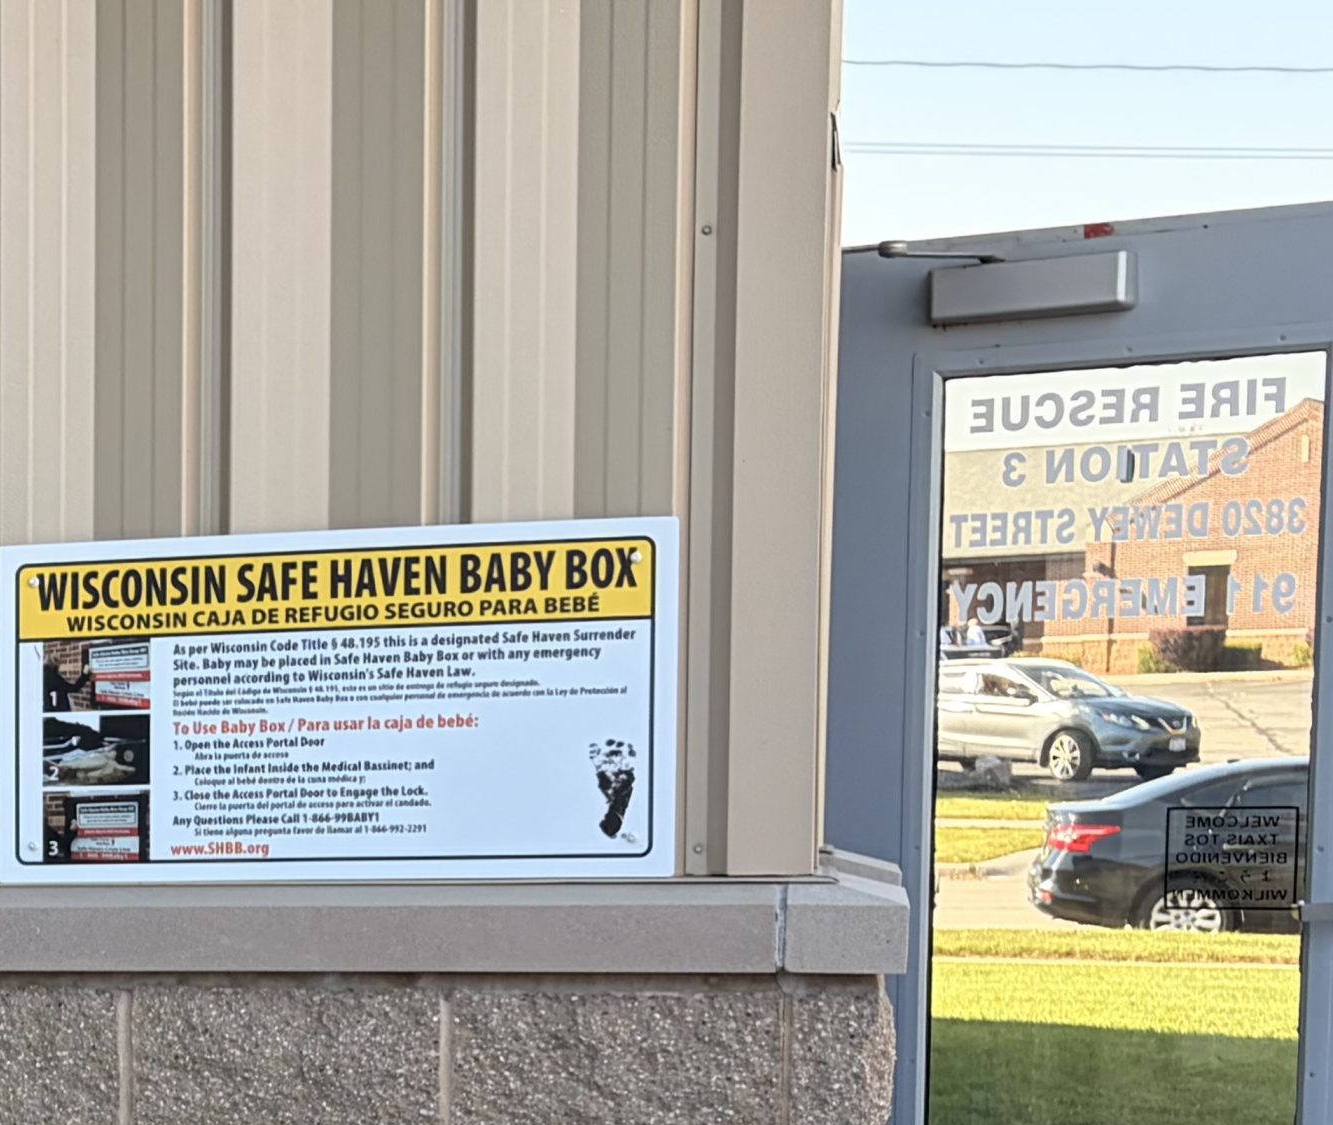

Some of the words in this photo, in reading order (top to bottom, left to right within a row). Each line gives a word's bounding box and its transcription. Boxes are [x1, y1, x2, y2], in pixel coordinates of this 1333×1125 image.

[37, 565, 225, 610] WISCONSIN
[236, 560, 318, 602] SAFE
[329, 555, 446, 598] HAVEN
[459, 550, 555, 593] BABY
[565, 546, 637, 588] BOX
[66, 612, 186, 631] WISCONSIN
[192, 609, 245, 627] CAJA
[251, 607, 279, 624] DE
[284, 604, 379, 623] REFUGIO
[384, 600, 473, 619] SEGURO
[479, 598, 537, 615] PARA
[544, 592, 599, 613] BEBÉ
[173, 643, 185, 655] As
[188, 645, 207, 657] per
[210, 640, 267, 653] Wisconsin
[269, 639, 298, 651] Code
[300, 638, 328, 650] Title
[340, 636, 380, 648] 48.195
[383, 635, 406, 647] this
[408, 635, 418, 646] is
[420, 637, 428, 646] a
[430, 632, 499, 648] designated
[502, 631, 528, 643] Safe
[531, 631, 570, 642] Haven
[573, 628, 636, 641] Surrender
[173, 659, 199, 670] Site.
[202, 657, 231, 671] Baby
[233, 659, 258, 670] may
[260, 656, 275, 667] be
[278, 654, 317, 669] placed
[319, 654, 331, 665] in
[333, 653, 359, 665] Safe
[362, 652, 400, 663] Haven
[403, 651, 433, 664] Baby
[436, 650, 458, 661] Box
[461, 651, 474, 660] or
[477, 648, 504, 660] with
[507, 649, 530, 661] any
[532, 647, 601, 660] emergency
[172, 673, 230, 688] personnel
[233, 672, 289, 684] according
[292, 671, 305, 682] to
[377, 668, 403, 679] Safe
[406, 667, 443, 678] Haven
[446, 666, 475, 677] Law.
[50, 691, 58, 706] 1
[172, 721, 189, 735] To
[192, 721, 216, 734] Use
[220, 719, 255, 735] Baby
[259, 719, 285, 732] Box
[297, 717, 329, 731] Para
[333, 719, 364, 730] usar
[367, 715, 380, 730] la
[383, 714, 412, 732] caja
[416, 714, 434, 728] de
[437, 713, 478, 728] bebé:
[184, 739, 210, 751] Open
[212, 738, 230, 749] the
[232, 738, 264, 748] Access
[266, 736, 298, 747] Portal
[300, 736, 324, 746] Door
[49, 766, 59, 780] 2
[49, 841, 59, 856] 3
[170, 841, 270, 858] www.SHBB.org
